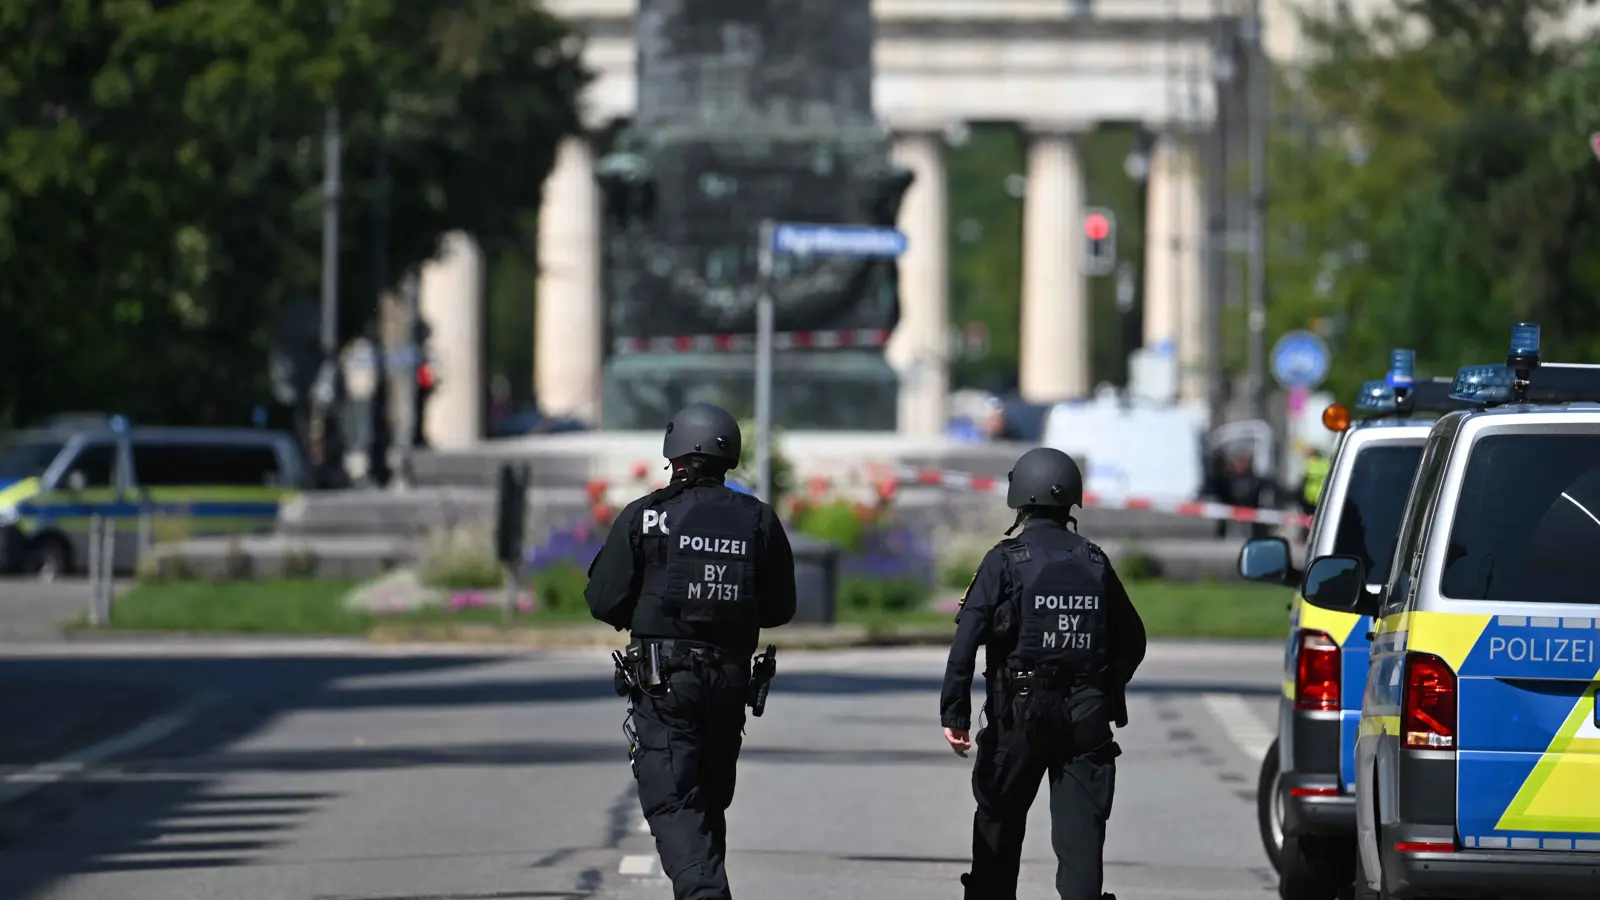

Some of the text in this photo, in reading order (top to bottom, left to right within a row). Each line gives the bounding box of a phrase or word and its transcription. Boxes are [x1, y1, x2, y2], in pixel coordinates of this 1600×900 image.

[679, 535, 746, 555] POLIZEI
[704, 564, 727, 582] BY
[687, 583, 738, 601] M 7131
[1034, 595, 1099, 610] POLIZEI
[1058, 614, 1080, 631] BY
[1042, 631, 1091, 649] M 7131
[1488, 636, 1594, 663] POLIZEI
